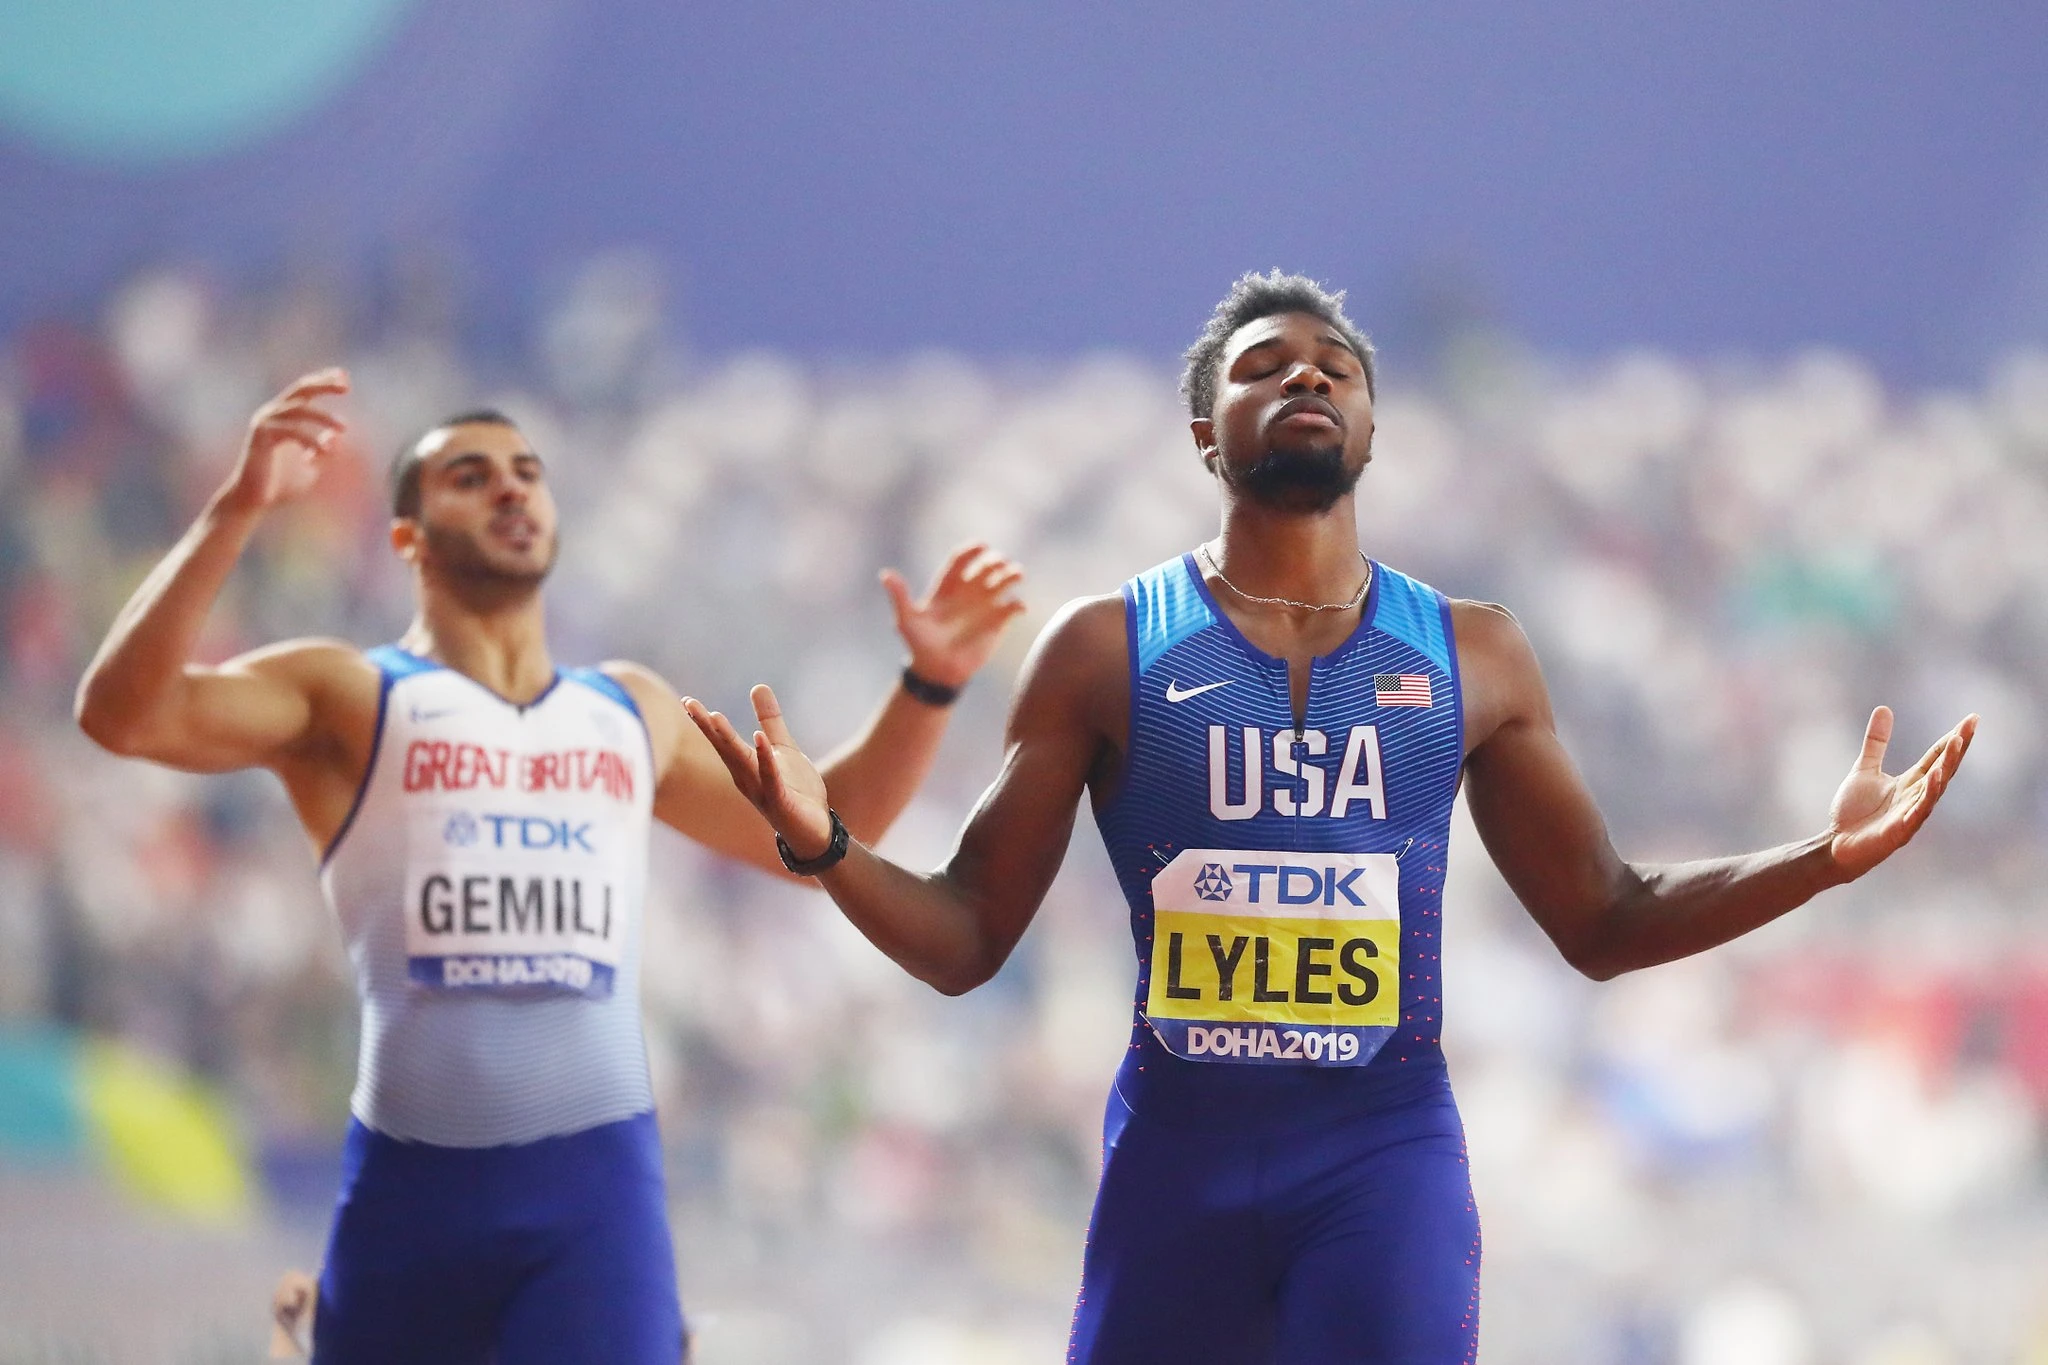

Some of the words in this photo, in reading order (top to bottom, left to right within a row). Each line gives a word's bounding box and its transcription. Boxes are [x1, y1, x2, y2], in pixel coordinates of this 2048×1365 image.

[403, 740, 509, 793] GREAT
[518, 749, 635, 804] BRITAIN
[1208, 725, 1387, 821] USA
[481, 813, 595, 853] TDK
[420, 874, 611, 940] GEMILI
[1233, 864, 1367, 906] TDK
[1166, 932, 1379, 1007] LYLES
[1187, 1026, 1360, 1061] DOHA2019
